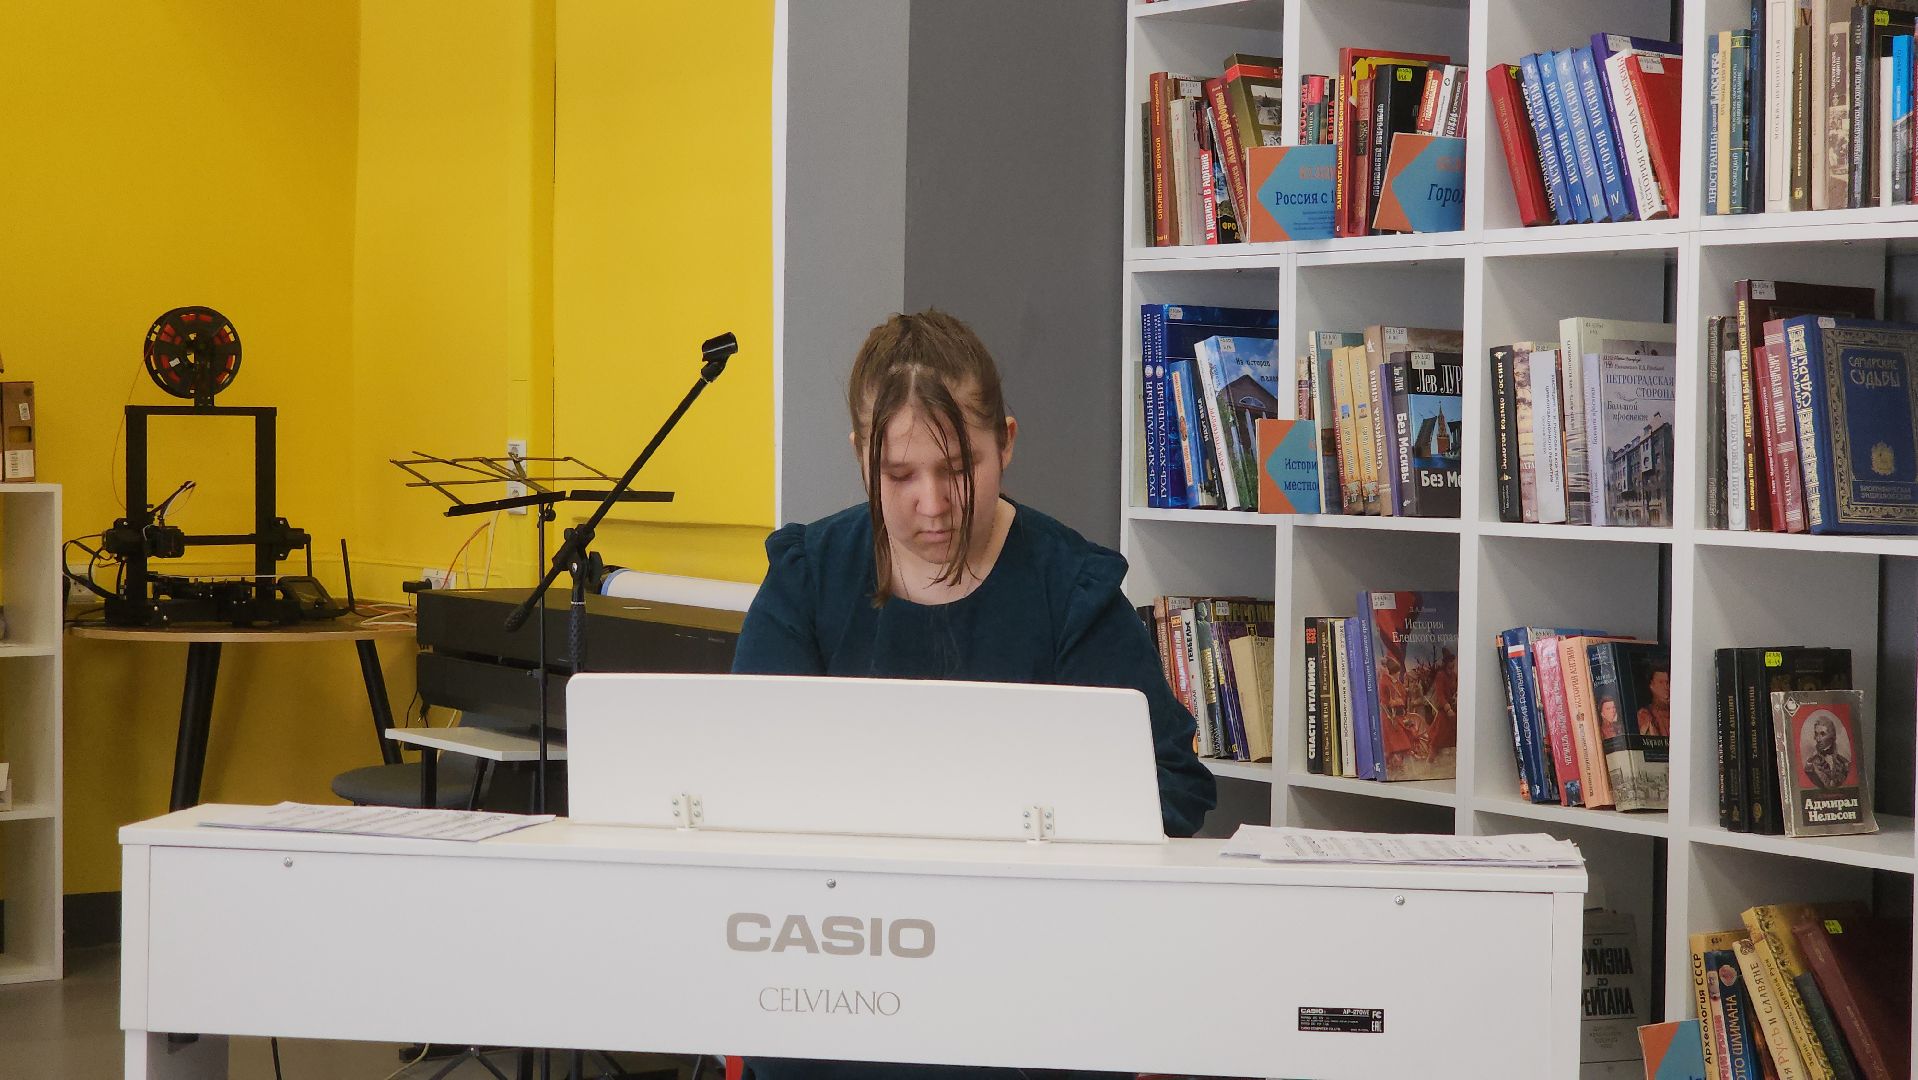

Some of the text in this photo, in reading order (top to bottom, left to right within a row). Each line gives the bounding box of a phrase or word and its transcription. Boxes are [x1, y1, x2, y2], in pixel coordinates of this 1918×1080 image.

[1615, 56, 1634, 106] МОСКВЫ
[1583, 78, 1603, 128] МОСКВЫ
[1529, 81, 1561, 185] ИСТОРИЯ МОСКВЫ
[1545, 81, 1579, 184] ИСТОРИЯ МОСКВЫ
[1563, 80, 1594, 177] ИСТОРИЯ МОСКВЫ
[1626, 108, 1643, 153] ГОРОДА
[1596, 130, 1616, 183] ИСТОРИЯ
[1708, 132, 1717, 203] ИНОСТРАНЦЫ
[1275, 191, 1318, 206] Россия
[1321, 195, 1328, 203] с
[1637, 155, 1655, 209] ИСТОРИЯ
[1737, 300, 1746, 325] ЗЕМЛИ
[1739, 326, 1748, 369] РЯЗАНСКОЙ
[1849, 356, 1899, 369] САМАРСКИЕ
[1416, 369, 1438, 393] Лев
[1606, 374, 1674, 386] ПЕТРОГРАДСКАЯ
[1741, 371, 1749, 393] БЫЛИ
[1790, 357, 1803, 409] САМАРСКИЕ
[1797, 352, 1811, 407] СУДЬБЫ
[1850, 370, 1900, 389] СУДЬБЫ
[1145, 381, 1156, 496] ГУСЬ-ХРУСТАЛЬНЫЙ
[1156, 381, 1167, 497] ГУСЬ-ХРУСТАЛЬНЫЙ
[1743, 401, 1752, 437] ЛЕГЕНДЫ
[1396, 412, 1411, 483] Без Москвы
[1284, 481, 1319, 491] местно
[1420, 470, 1444, 488] Без
[1184, 620, 1193, 662] ГЕББЕЛЬС
[1392, 631, 1437, 644] Елецкого
[1404, 618, 1444, 631] История
[1307, 657, 1317, 759] СПАСТИ ИТАЛИЮ!
[1570, 675, 1582, 707] ИСТОРИЯ
[1519, 704, 1534, 744] ИСТОРИЯ
[1804, 798, 1858, 810] Адмирал
[1808, 811, 1856, 822] Нельсон
[726, 912, 936, 959] CASIO
[1582, 948, 1634, 975] УМЭНА
[758, 986, 901, 1017] CELVIANO
[1692, 952, 1712, 1064] Археология СССР
[1749, 961, 1773, 1014] СЛАВЯНЕ
[1724, 994, 1745, 1055] ШЛИМАНА
[1771, 1026, 1789, 1064] РУСЬ
